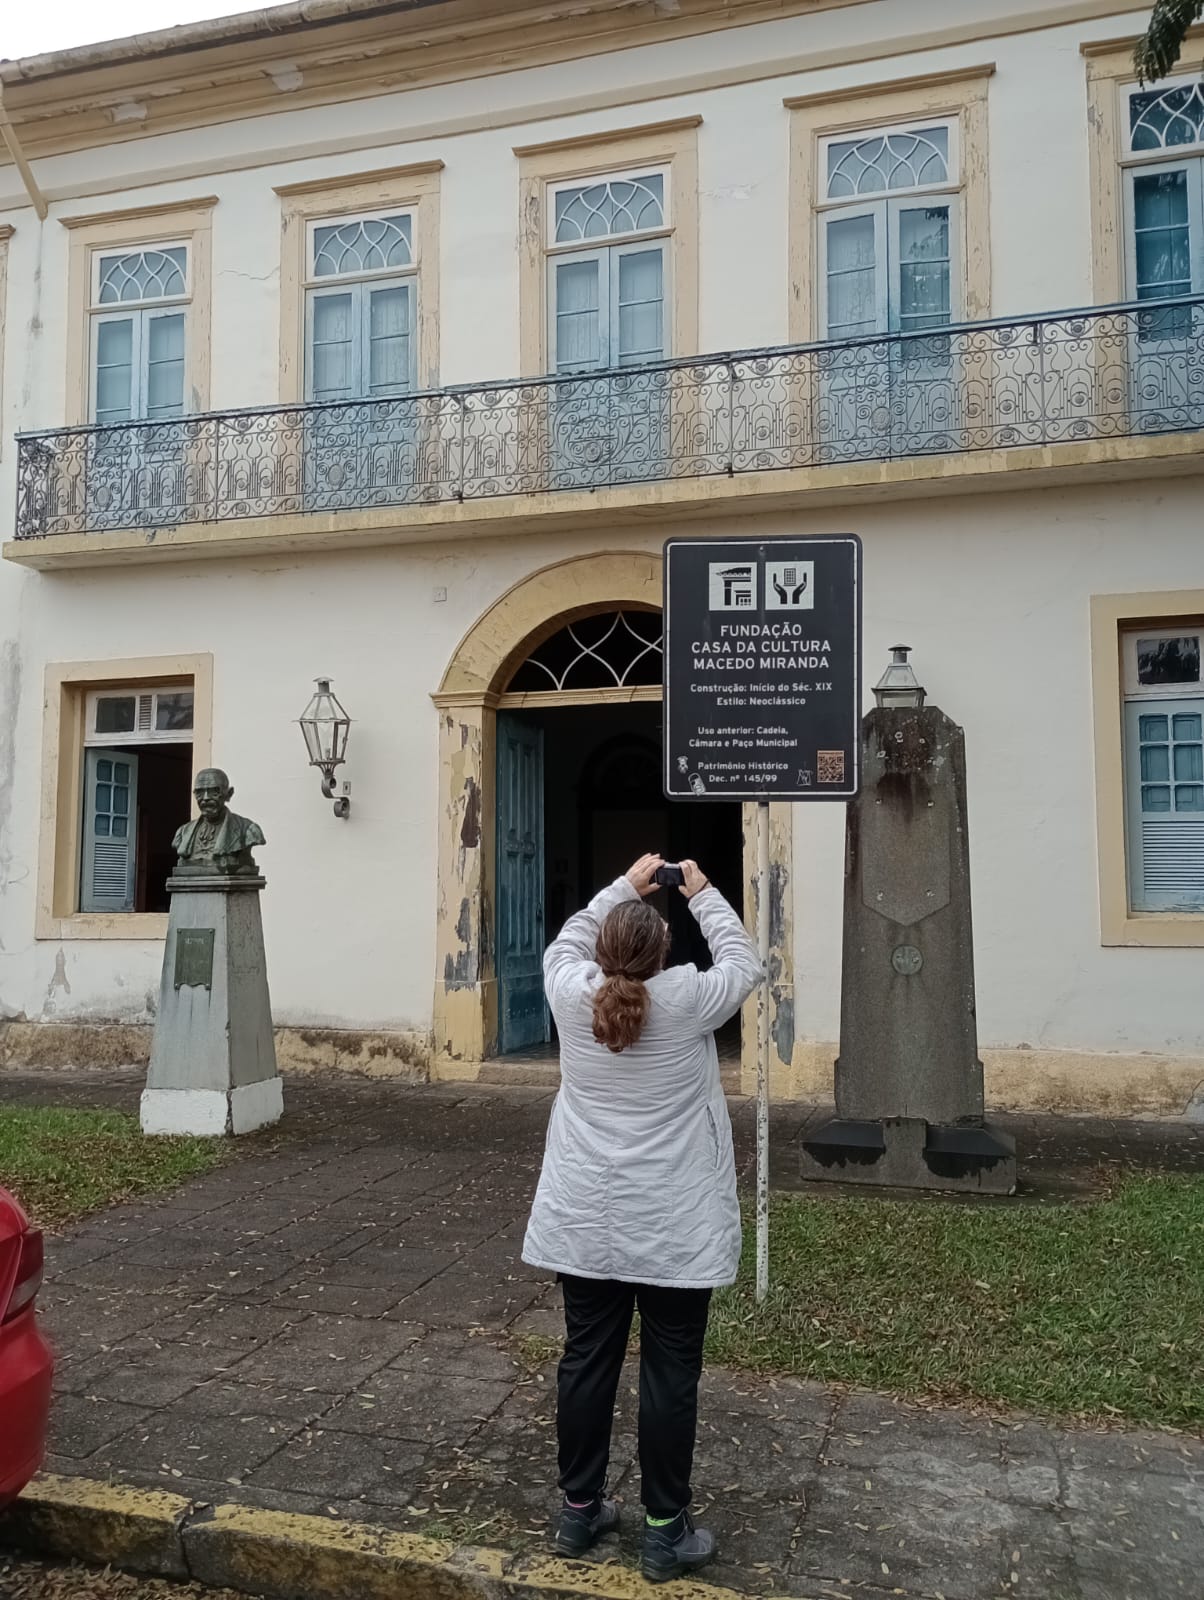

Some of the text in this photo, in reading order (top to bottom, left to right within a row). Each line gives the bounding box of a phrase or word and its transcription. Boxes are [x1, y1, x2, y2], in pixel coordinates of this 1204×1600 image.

[721, 622, 802, 638] FUNDAÇÃO
[691, 640, 831, 654] CASA DA CULTURA
[694, 656, 829, 670] MACEDO MIRANDA
[690, 682, 832, 693] Construção: Início do Séc. XIX
[716, 696, 806, 706] Estilo: Neoclássico
[698, 726, 788, 735] Uso anterior: Cadeia,
[689, 738, 722, 747] Câmara
[732, 739, 754, 748] Paço
[756, 738, 798, 747] Municipal
[748, 761, 788, 770] Histórico
[709, 774, 728, 783] Dec.
[744, 774, 778, 783] 145/99
